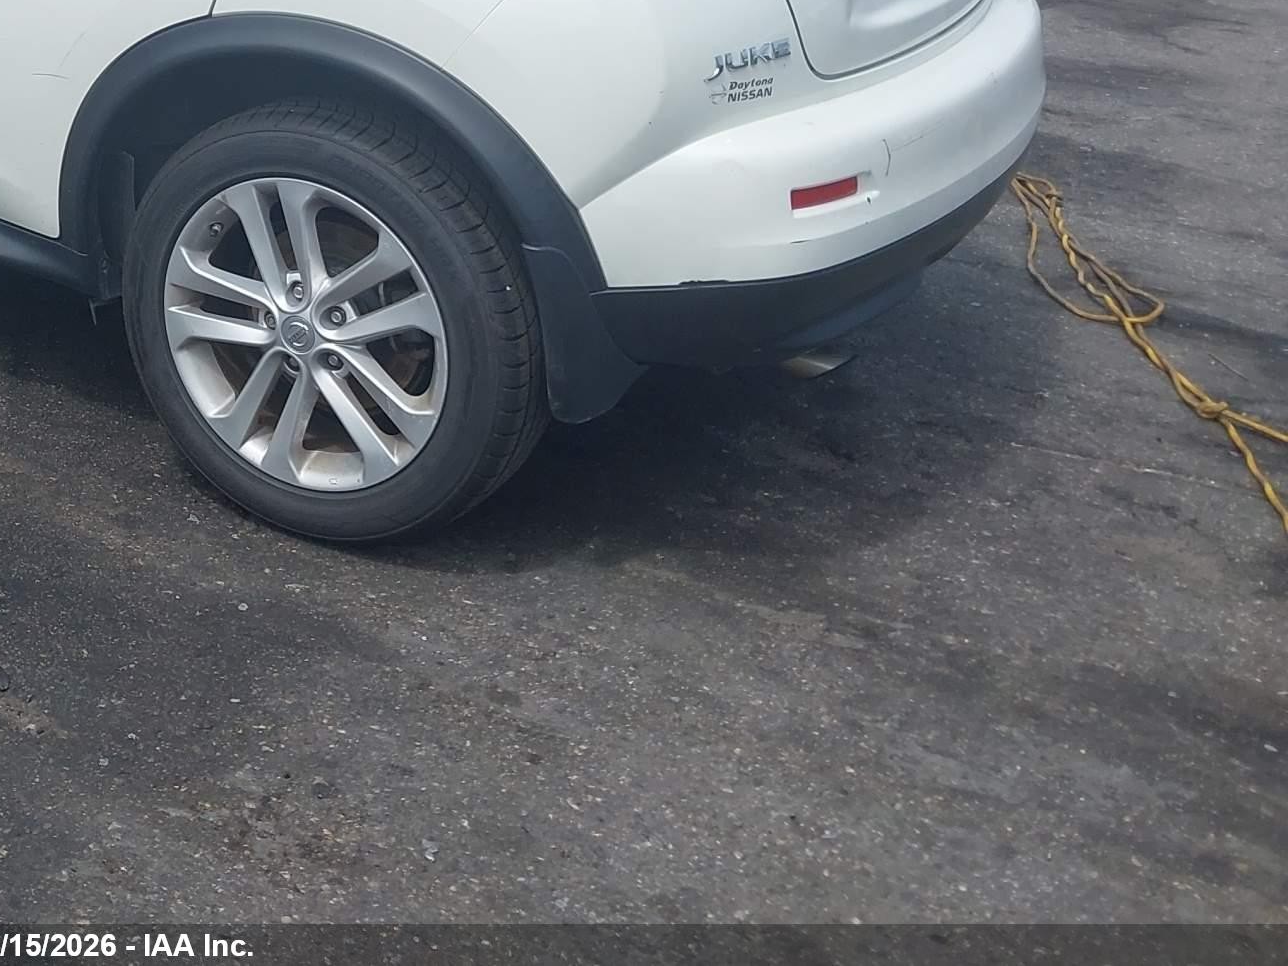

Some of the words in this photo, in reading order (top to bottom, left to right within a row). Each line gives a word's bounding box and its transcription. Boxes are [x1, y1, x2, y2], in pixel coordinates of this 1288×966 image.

[703, 37, 791, 83] JUKE
[728, 77, 773, 91] Daytona
[727, 87, 773, 103] NISSAN
